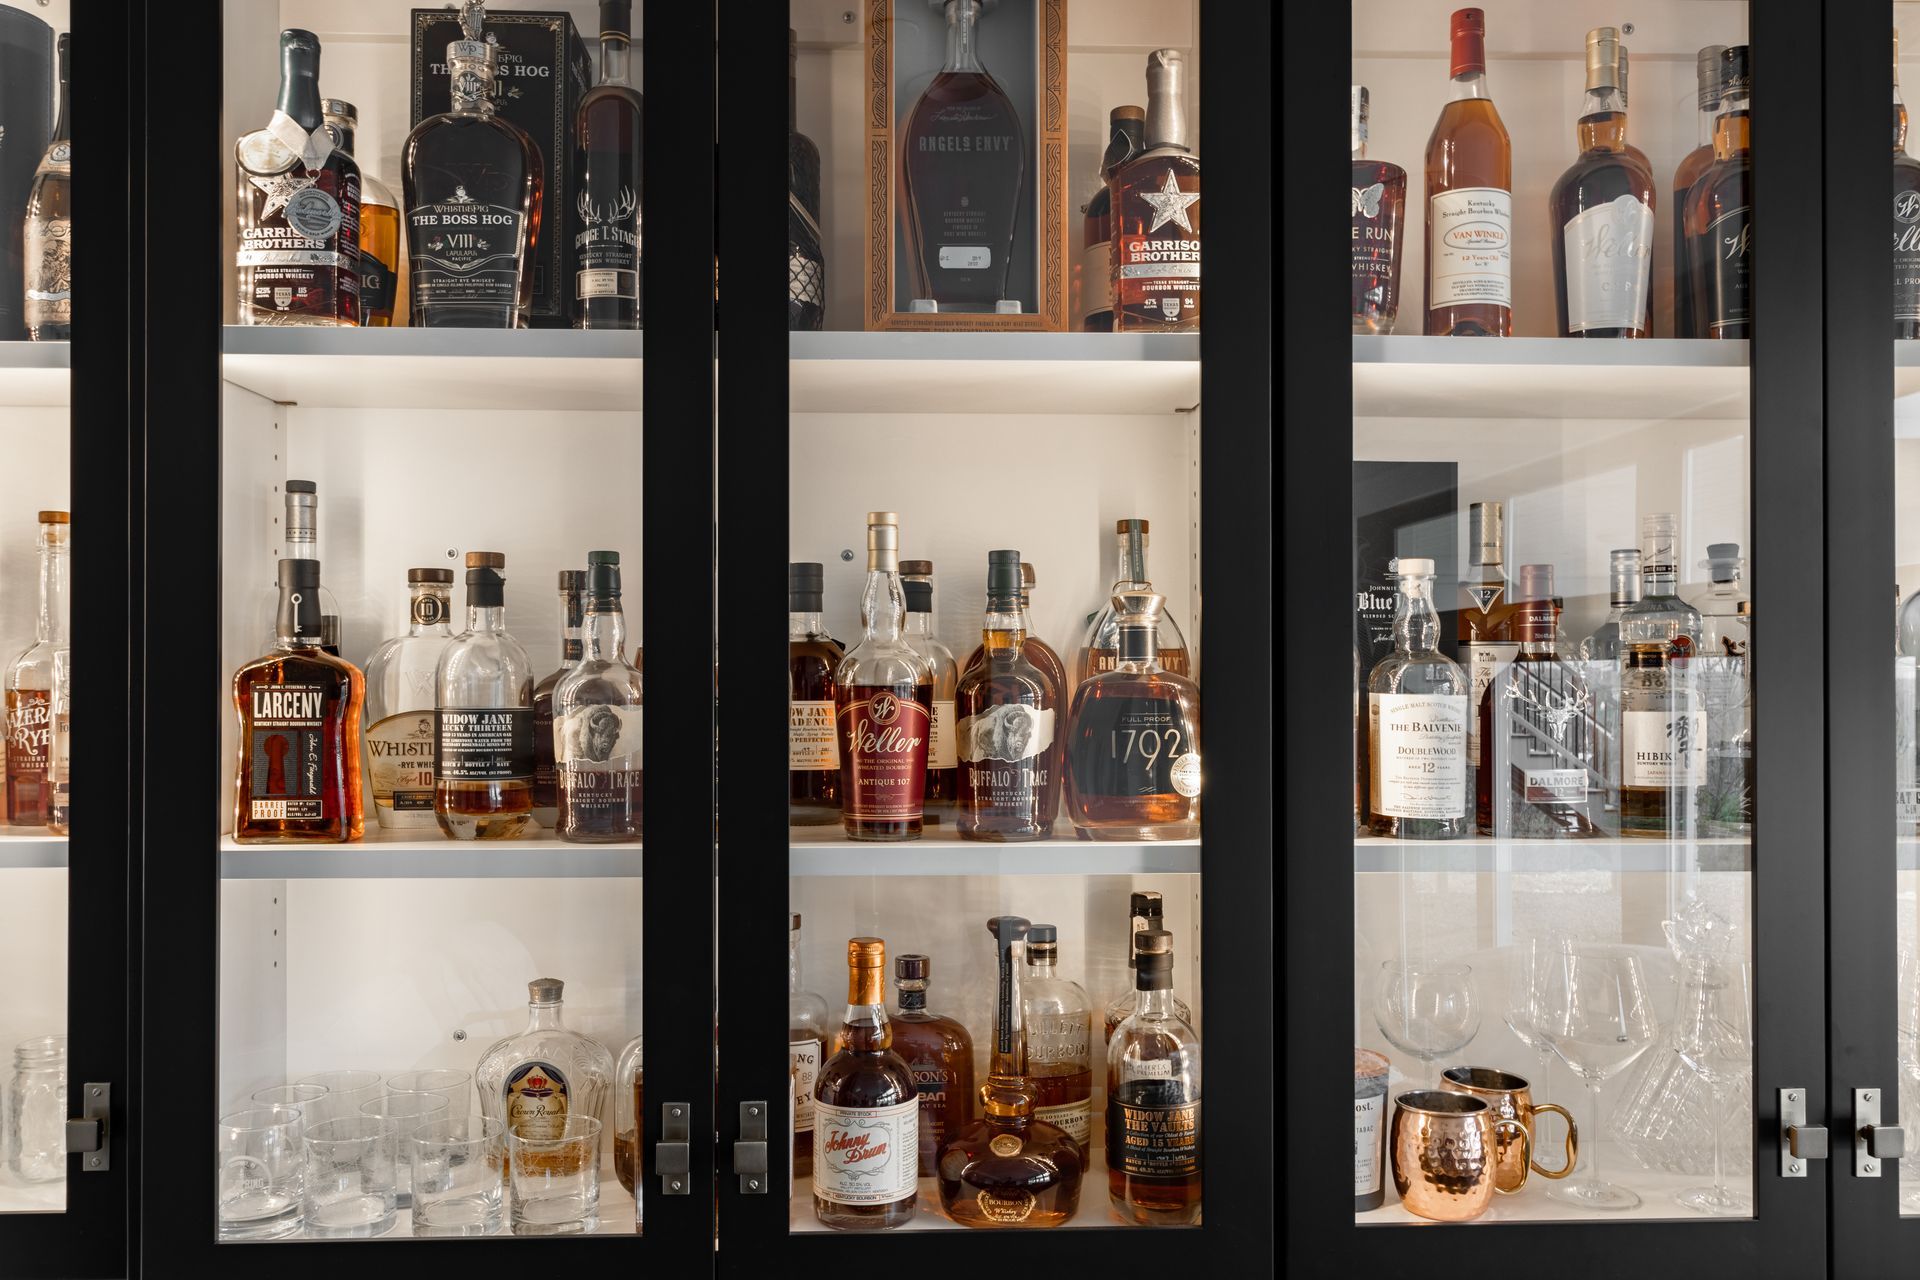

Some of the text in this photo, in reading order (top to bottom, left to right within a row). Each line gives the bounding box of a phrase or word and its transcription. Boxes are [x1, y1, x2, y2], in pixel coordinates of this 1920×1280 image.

[515, 65, 549, 77] HOG
[413, 215, 512, 226] THE BOSS HOG
[1366, 227, 1392, 241] RUN
[1452, 230, 1504, 240] VAN WINKLE
[242, 239, 325, 249] BROTHERS
[446, 234, 473, 248] VIII
[1480, 590, 1491, 598] 12
[1356, 592, 1392, 611] Blue
[421, 603, 433, 616] 10
[254, 692, 322, 718] LARCENY
[442, 714, 512, 724] WIDOW JANE
[1390, 722, 1462, 732] THE BALVENIE
[846, 718, 922, 753] Weller
[1112, 729, 1181, 771] 1792
[1422, 762, 1435, 773] 12
[419, 772, 432, 785] 10
[609, 770, 640, 789] TRACE
[858, 778, 895, 787] ANTIQUE
[969, 768, 1048, 788] BUFFALO TRACE
[1530, 776, 1584, 786] DALMORE
[254, 809, 284, 818] PROOF
[802, 1072, 812, 1081] 88
[510, 1104, 559, 1118] Crown Royal
[1124, 1108, 1195, 1121] WIDOW JANE
[1125, 1119, 1195, 1132] THE VAULTS
[1356, 1125, 1374, 1134] TABAC
[825, 1131, 887, 1164] Johnny Drum
[1125, 1136, 1195, 1148] AGED 15 YEARS
